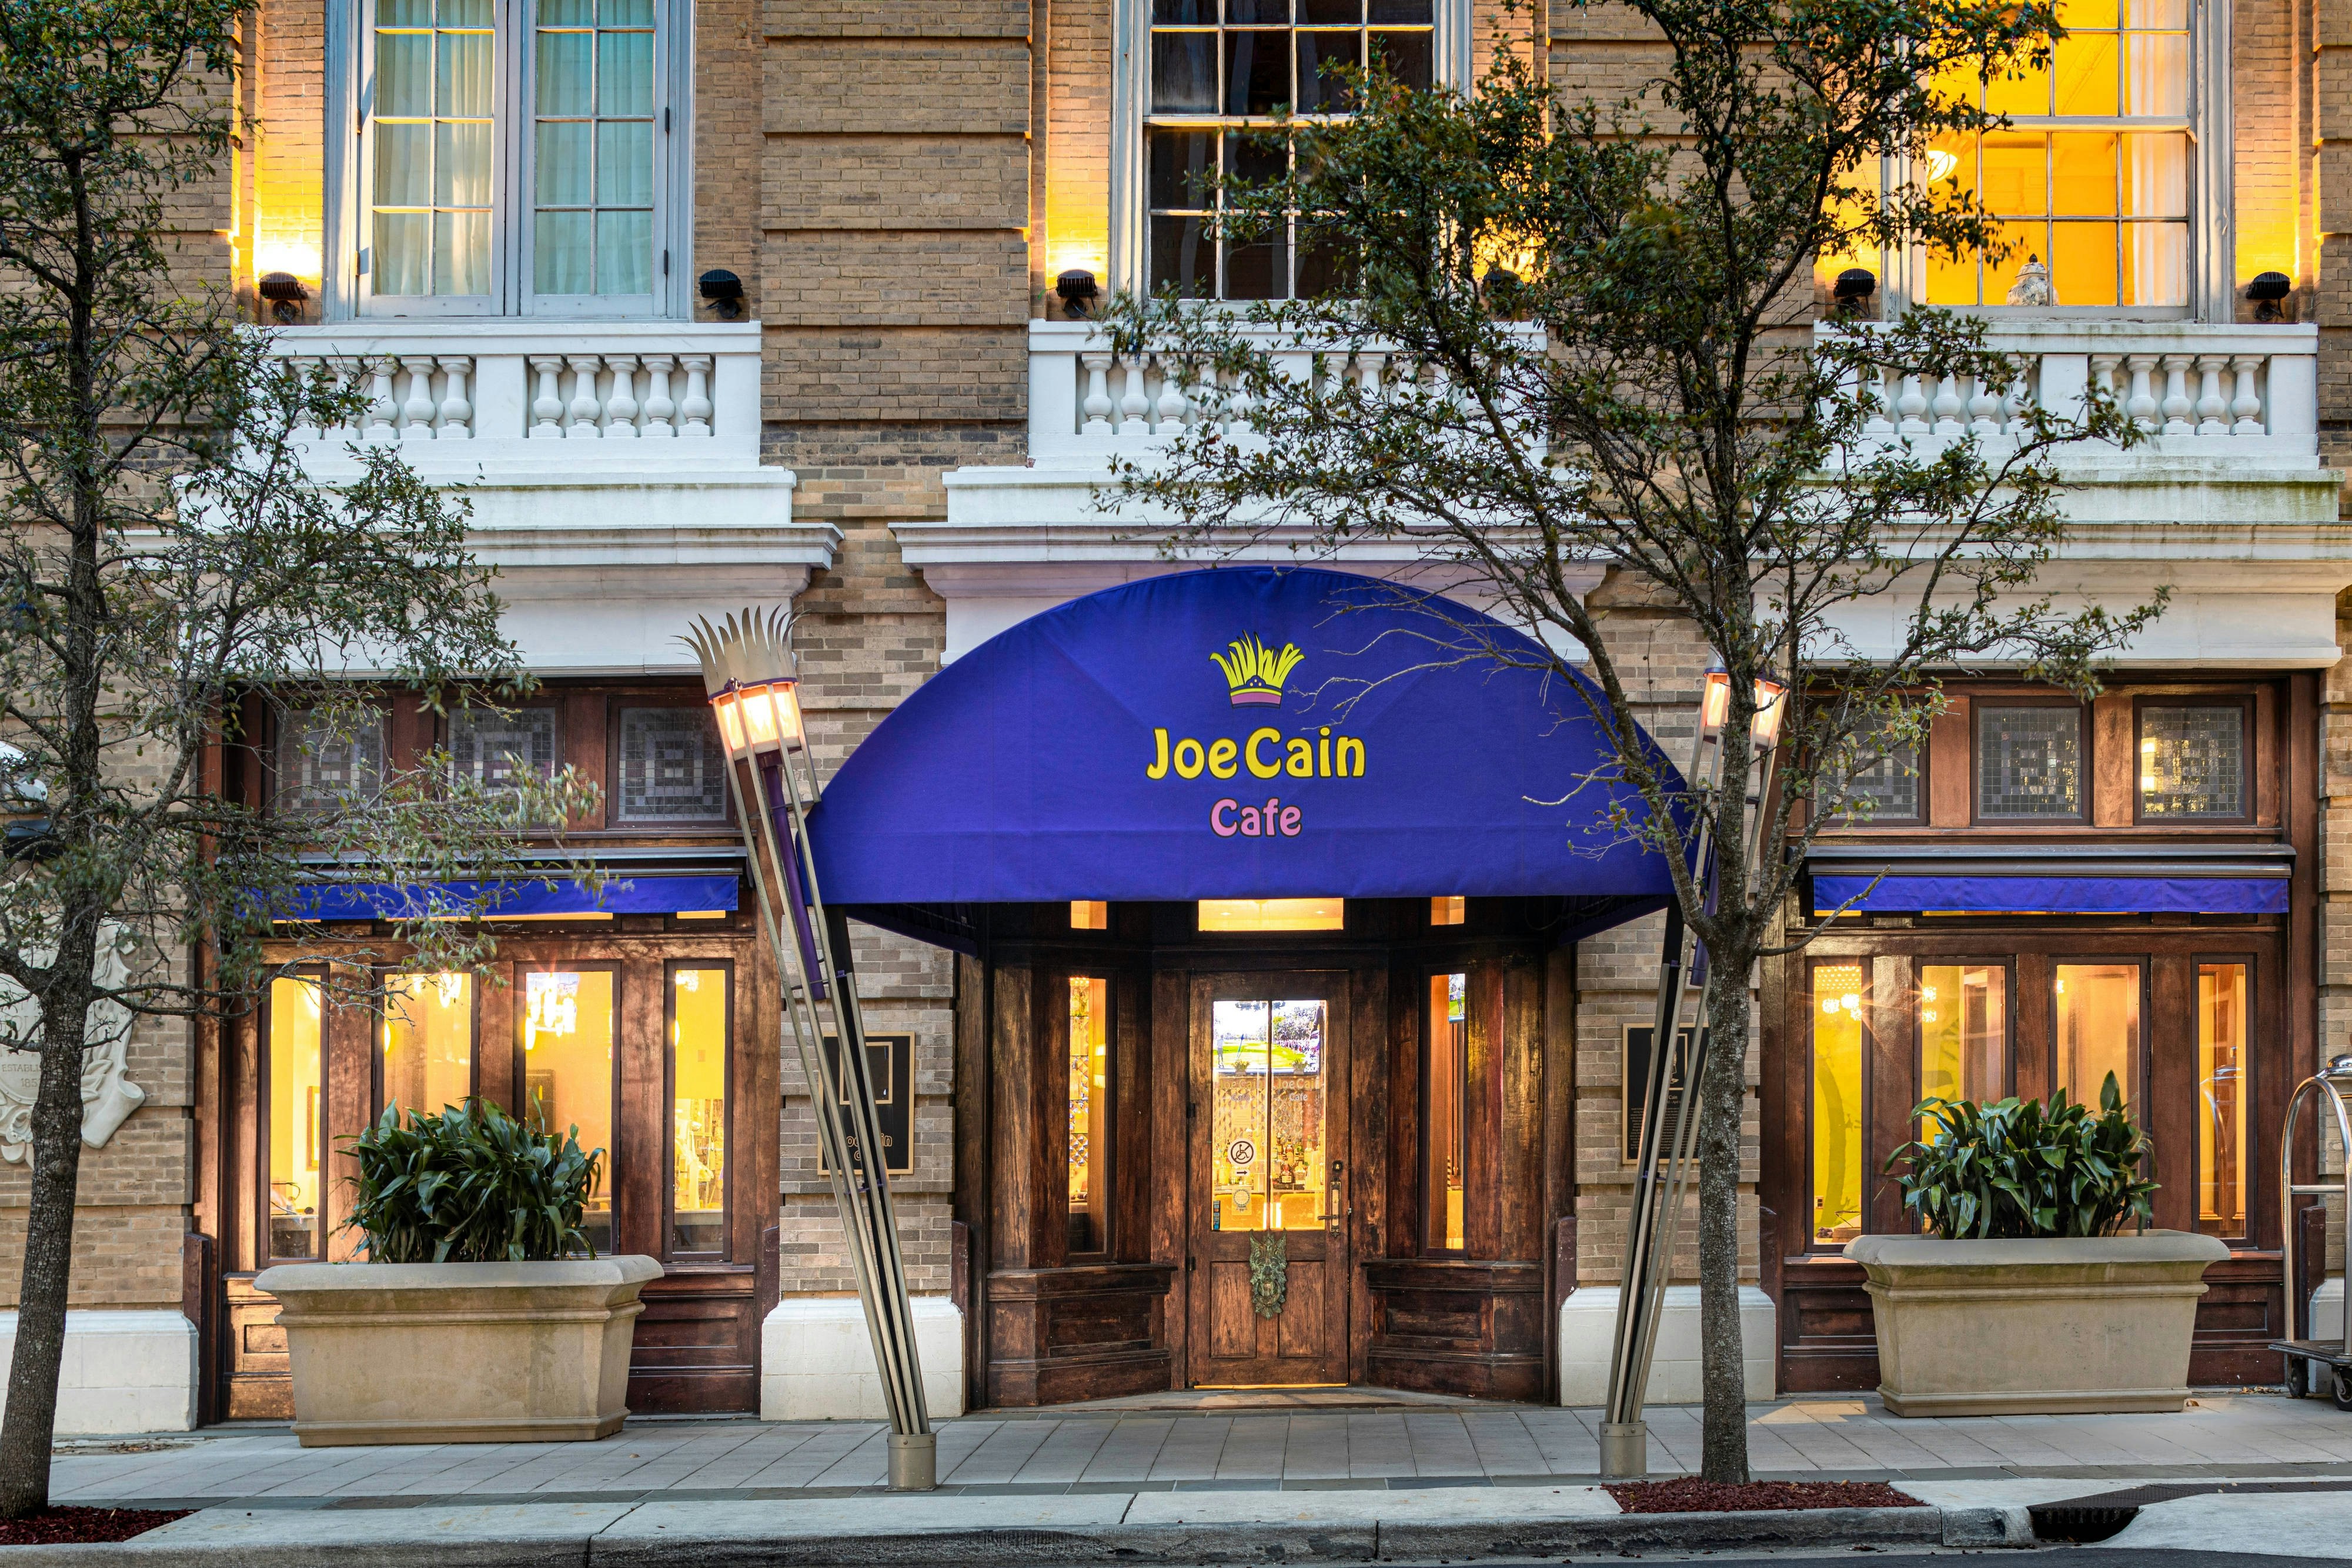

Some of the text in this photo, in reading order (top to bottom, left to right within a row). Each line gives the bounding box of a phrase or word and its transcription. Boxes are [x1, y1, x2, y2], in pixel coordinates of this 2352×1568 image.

[1145, 726, 1367, 780] Joe Cain
[1209, 797, 1303, 838] Cafe
[2, 1064, 41, 1072] ESTABLI
[21, 1078, 41, 1087] 185
[1275, 1078, 1294, 1089] Joe
[1289, 1092, 1308, 1101] Cafe
